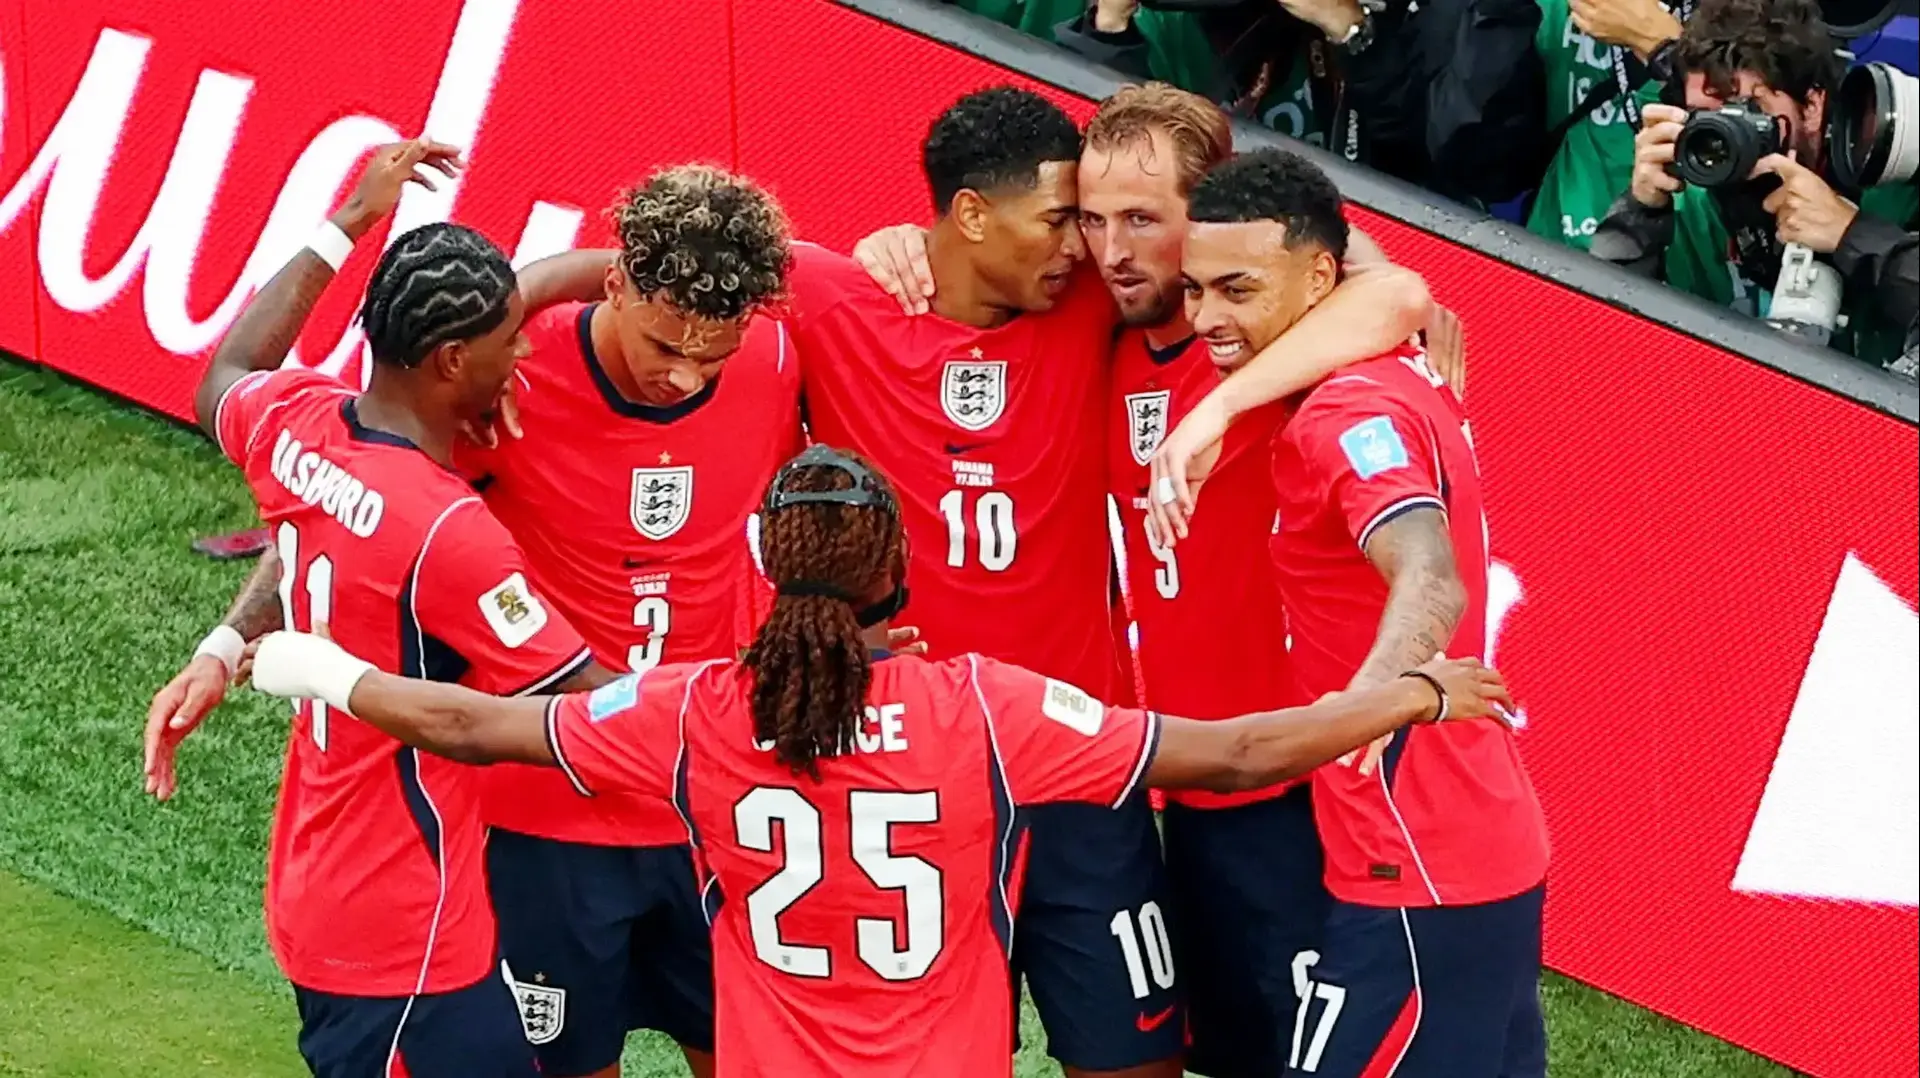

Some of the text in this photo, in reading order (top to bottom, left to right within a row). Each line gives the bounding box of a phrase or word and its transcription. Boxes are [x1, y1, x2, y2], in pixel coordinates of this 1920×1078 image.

[939, 489, 1017, 571] 10
[627, 596, 670, 672] 3
[734, 786, 943, 981] 25
[1110, 900, 1175, 999] 10
[1288, 980, 1346, 1072] 17
